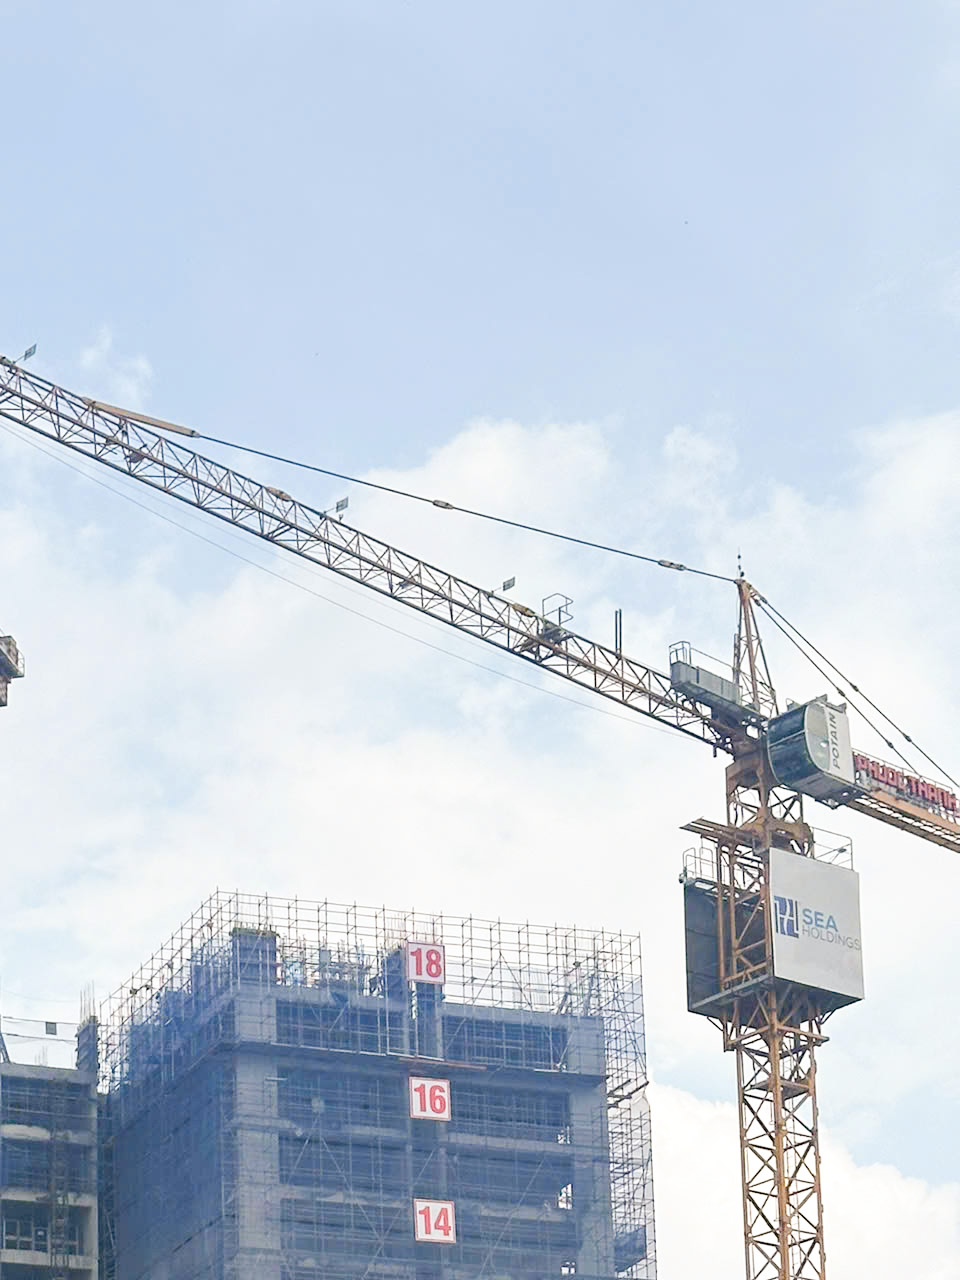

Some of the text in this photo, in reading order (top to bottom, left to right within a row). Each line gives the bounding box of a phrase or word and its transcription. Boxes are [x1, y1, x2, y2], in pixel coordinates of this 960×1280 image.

[830, 712, 841, 771] POTAIN
[802, 907, 838, 933] SEA
[802, 925, 862, 951] HOLDINGS
[410, 947, 443, 978] 18
[414, 1083, 447, 1114] 16
[418, 1206, 452, 1237] 14
